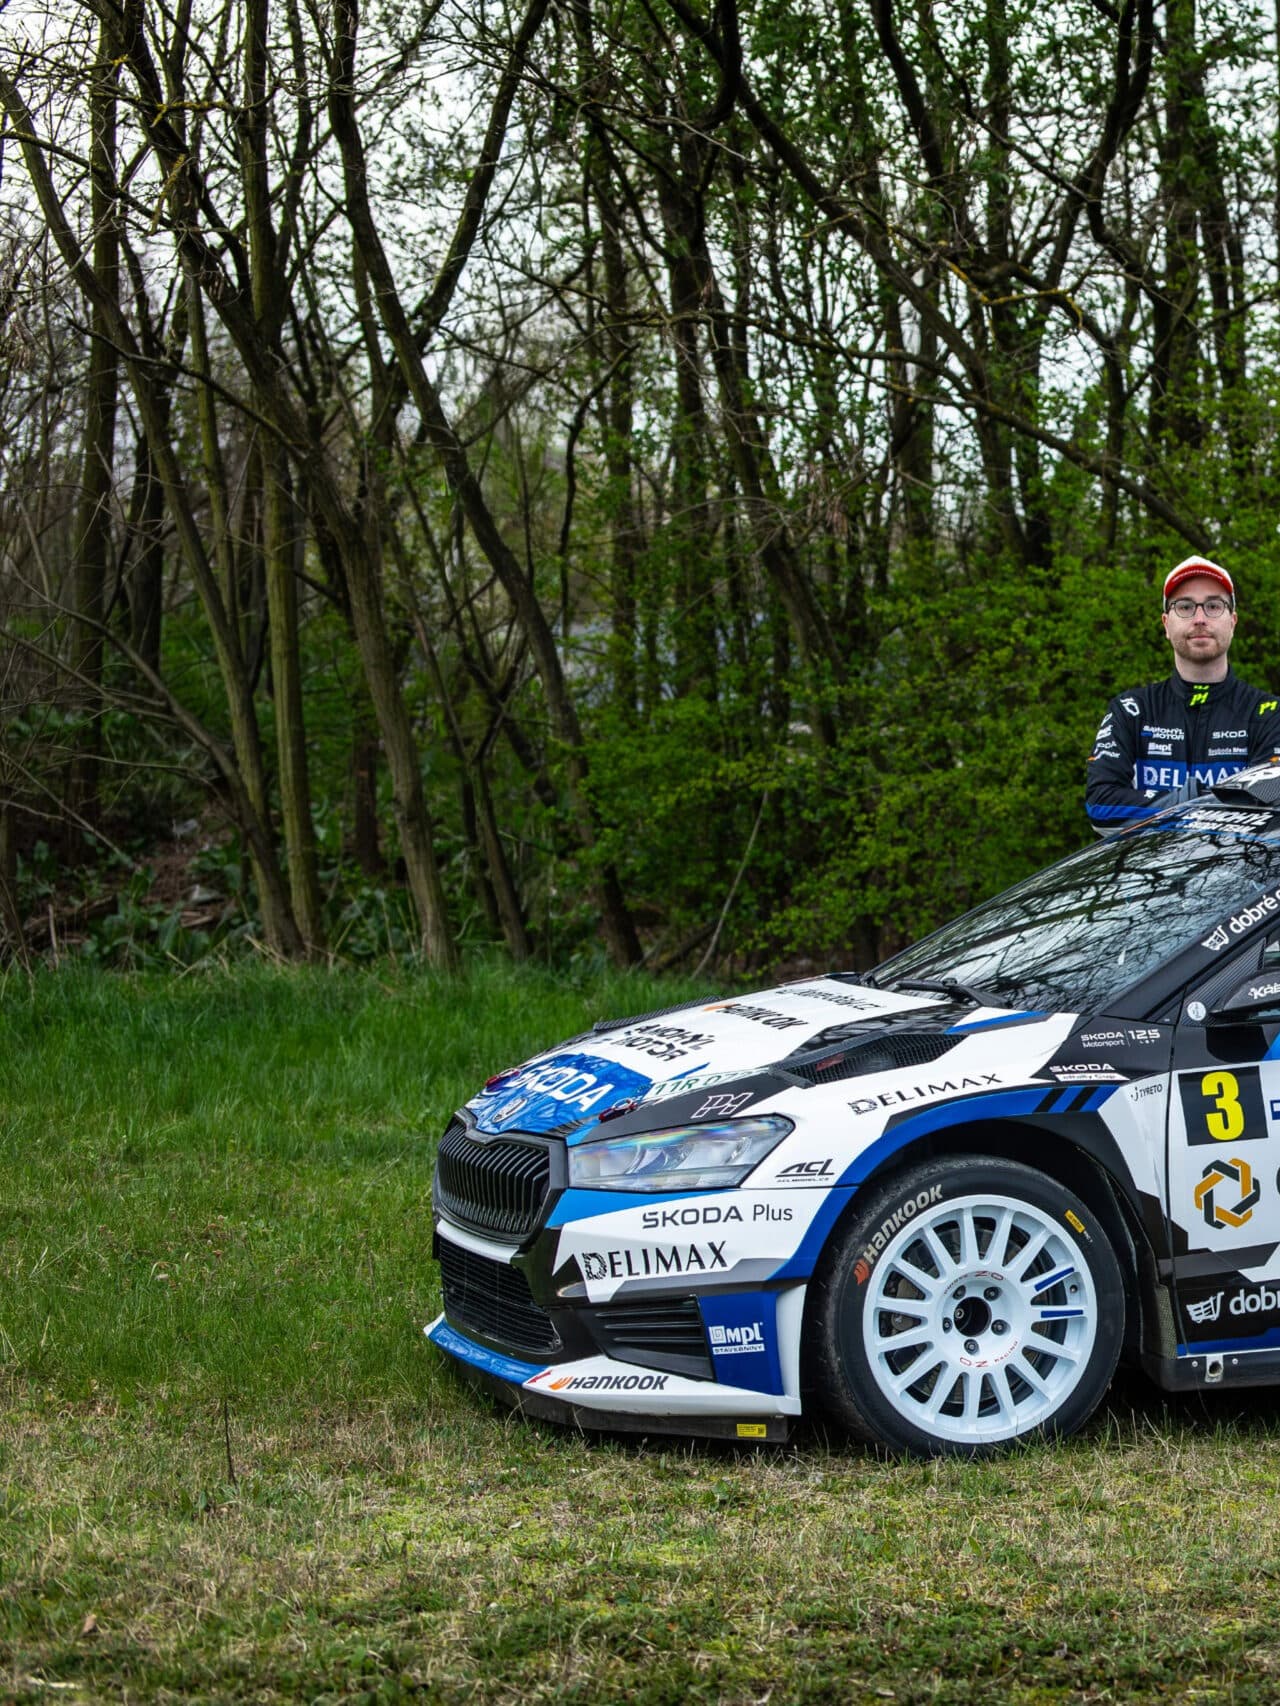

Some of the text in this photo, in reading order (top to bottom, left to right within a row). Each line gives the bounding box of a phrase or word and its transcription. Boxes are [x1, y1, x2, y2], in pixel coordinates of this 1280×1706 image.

[1212, 730, 1248, 739] SKOD
[1229, 896, 1278, 934] dobré
[1128, 1028, 1160, 1040] 125
[1049, 1063, 1115, 1072] SKODA
[848, 1074, 1002, 1115] DELIMAX
[1201, 1071, 1245, 1141] 3
[642, 1204, 793, 1228] SKODA Plus
[581, 1241, 728, 1281] DELIMAX
